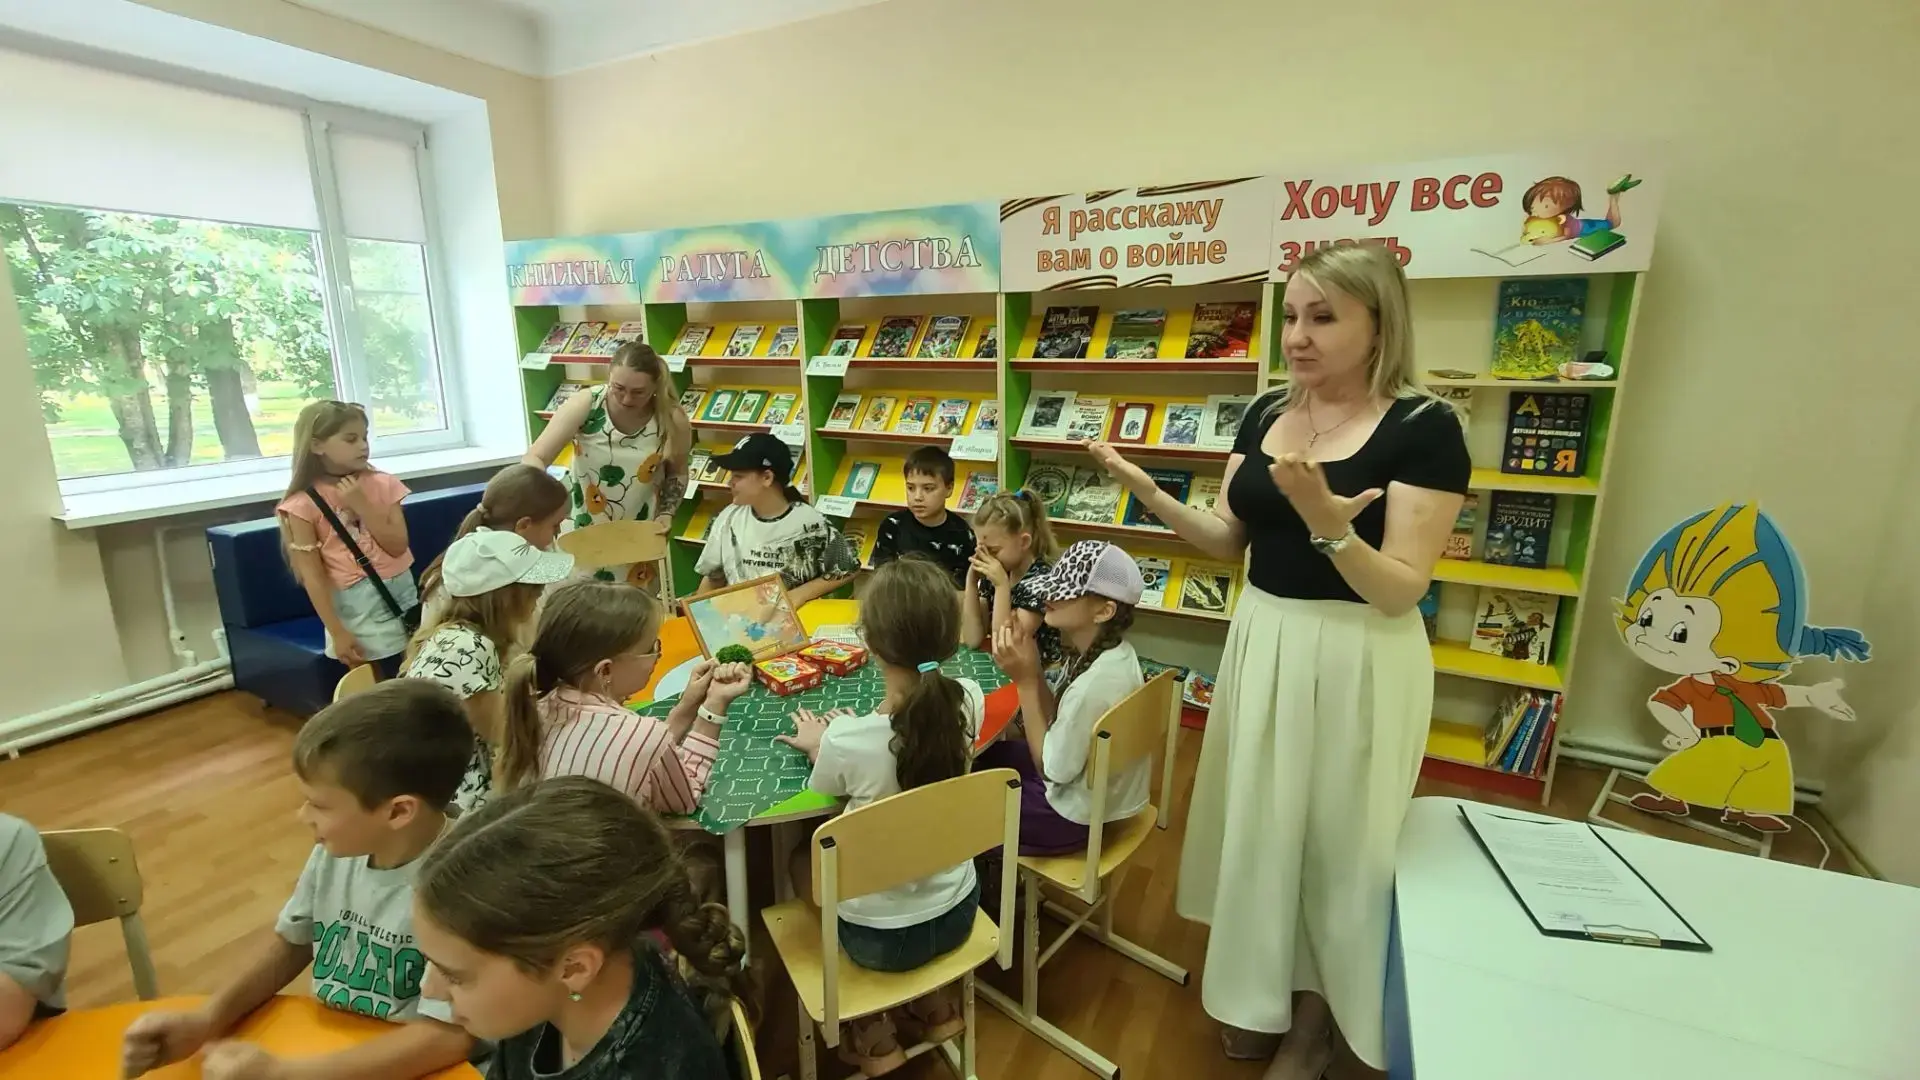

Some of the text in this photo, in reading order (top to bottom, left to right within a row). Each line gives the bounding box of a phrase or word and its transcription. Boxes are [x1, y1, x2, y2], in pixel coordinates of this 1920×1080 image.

[1042, 198, 1224, 241] Я расскажу
[1280, 171, 1503, 227] Хочу все
[507, 234, 982, 288] КНИЖНАЯ РАДУГА ДЕТСТВА
[1037, 231, 1228, 272] вам о войне
